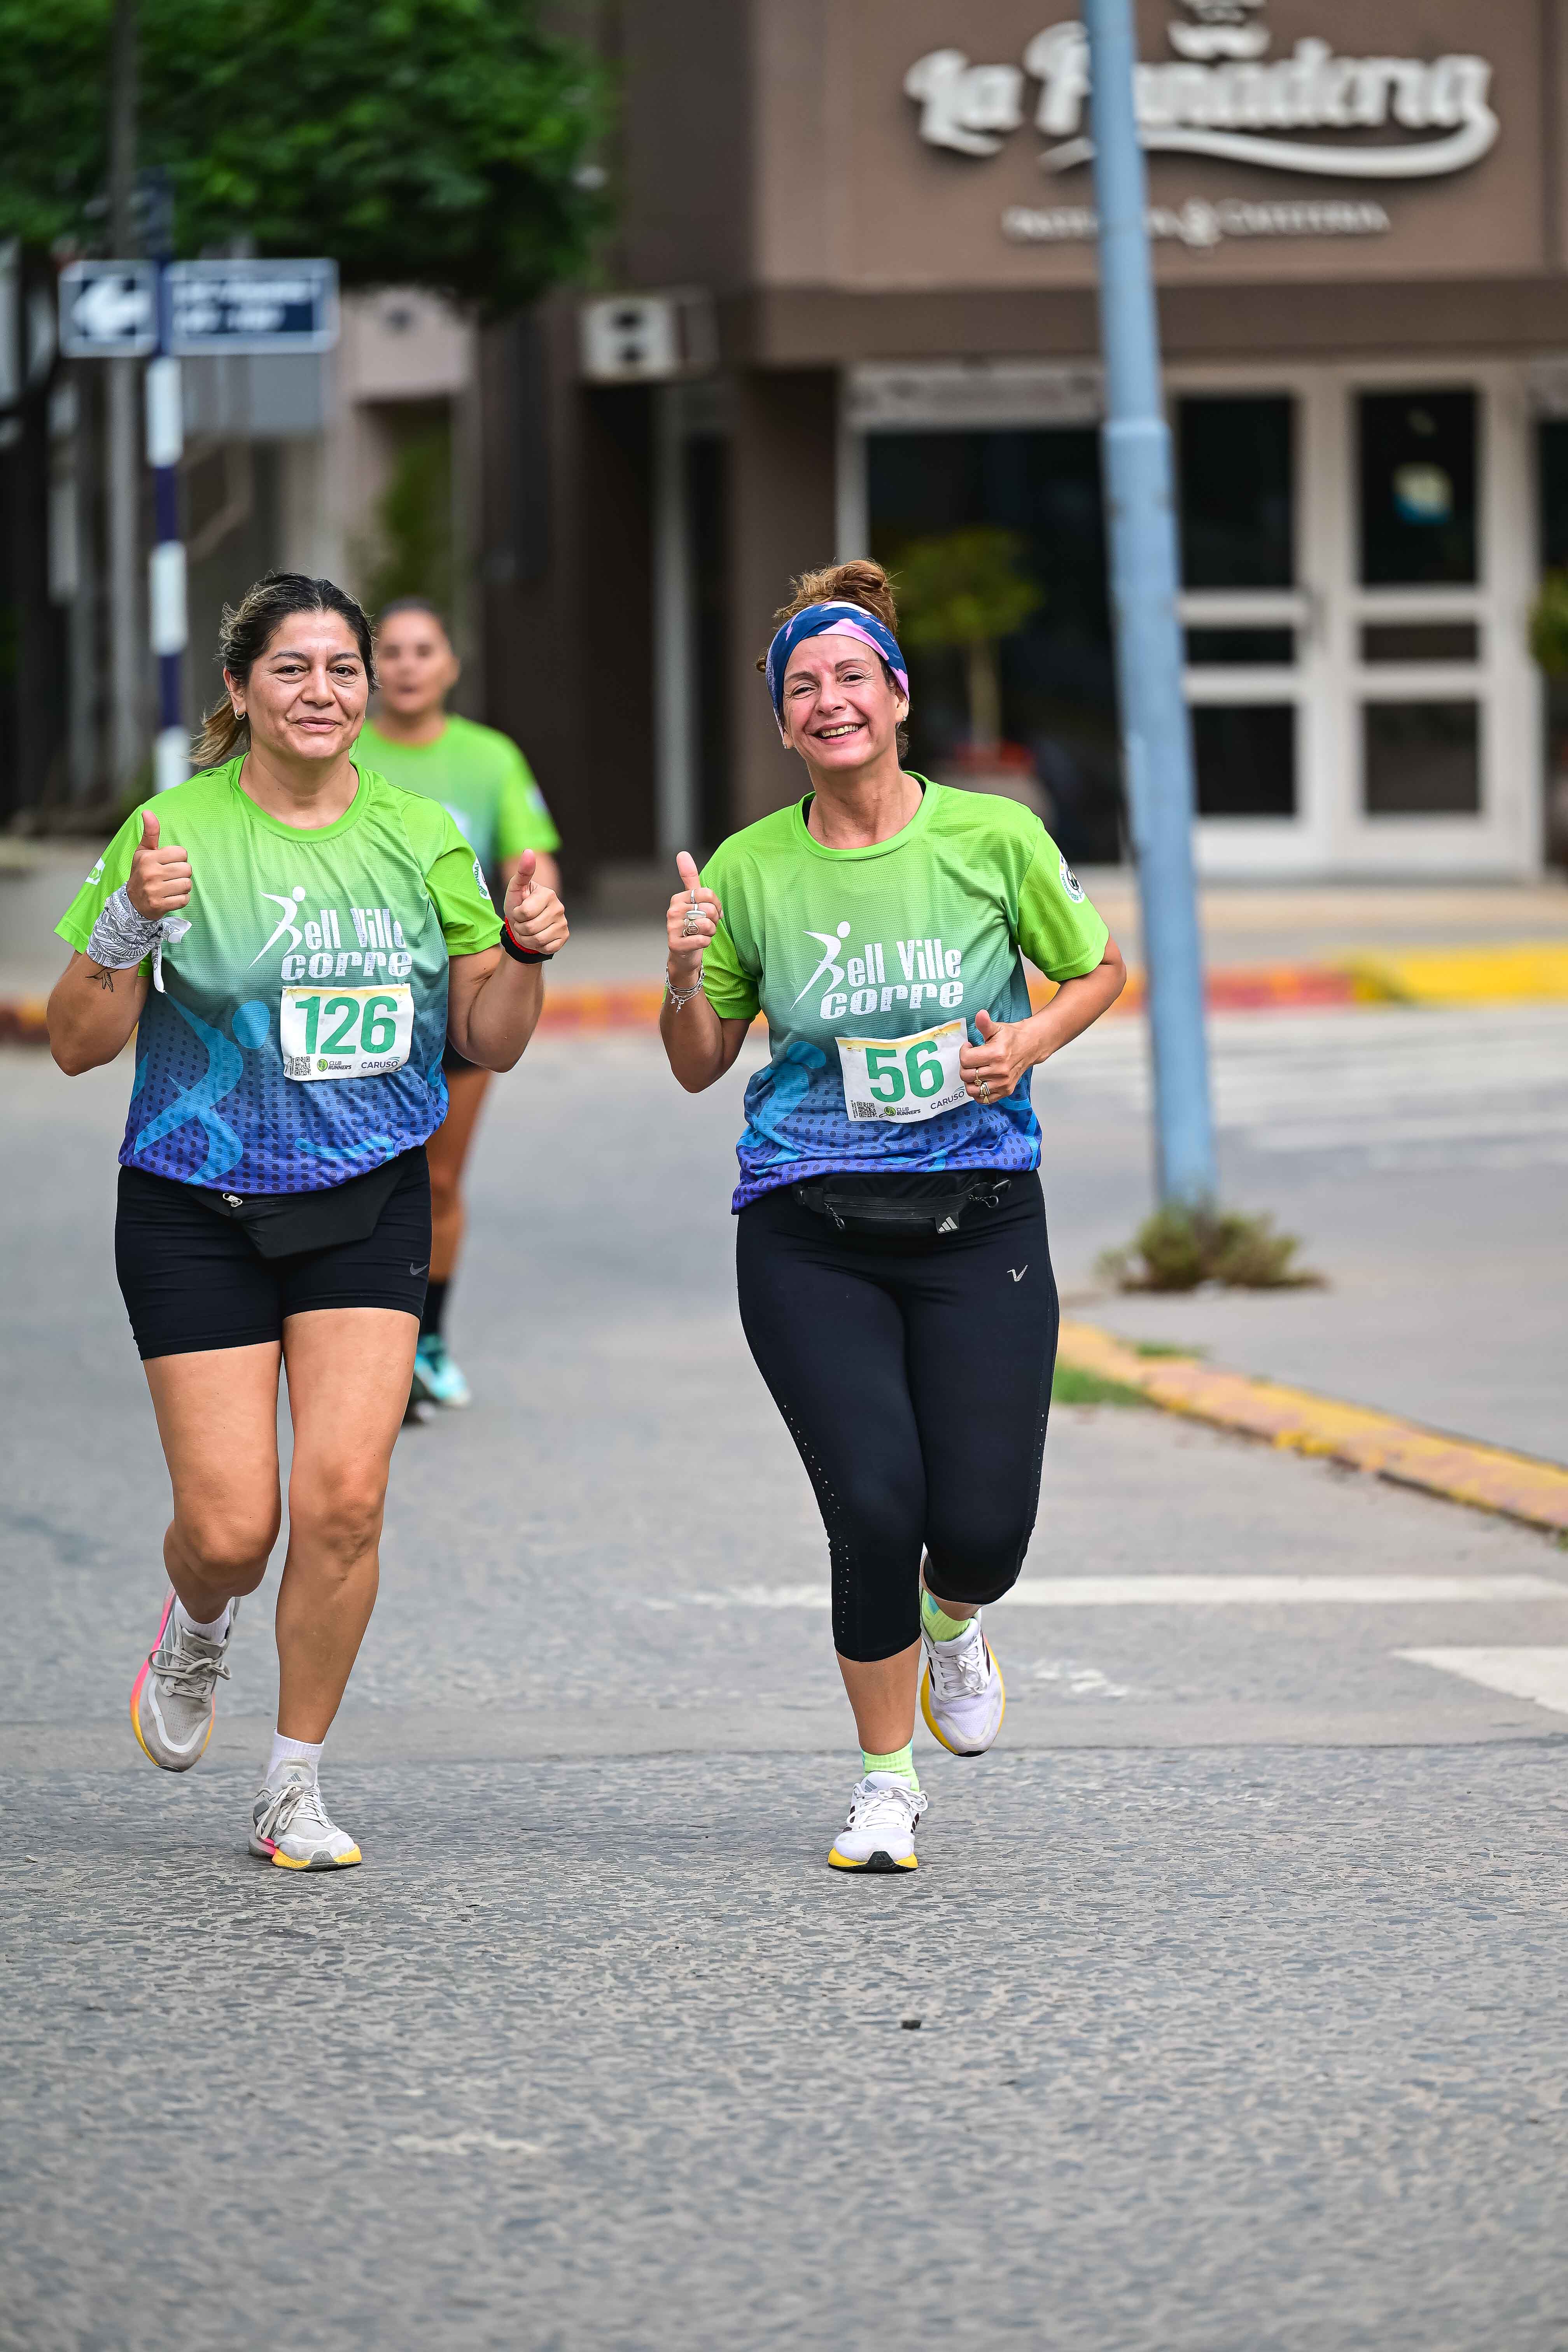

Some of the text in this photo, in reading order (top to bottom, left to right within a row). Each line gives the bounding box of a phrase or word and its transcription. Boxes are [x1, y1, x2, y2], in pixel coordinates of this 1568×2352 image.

[350, 908, 407, 949] Ville
[280, 951, 413, 981] corre
[896, 939, 962, 980] Ville
[820, 981, 964, 1020] corre
[296, 996, 398, 1054] 126
[865, 1040, 945, 1103] 56
[930, 1091, 965, 1110] CARUSO
